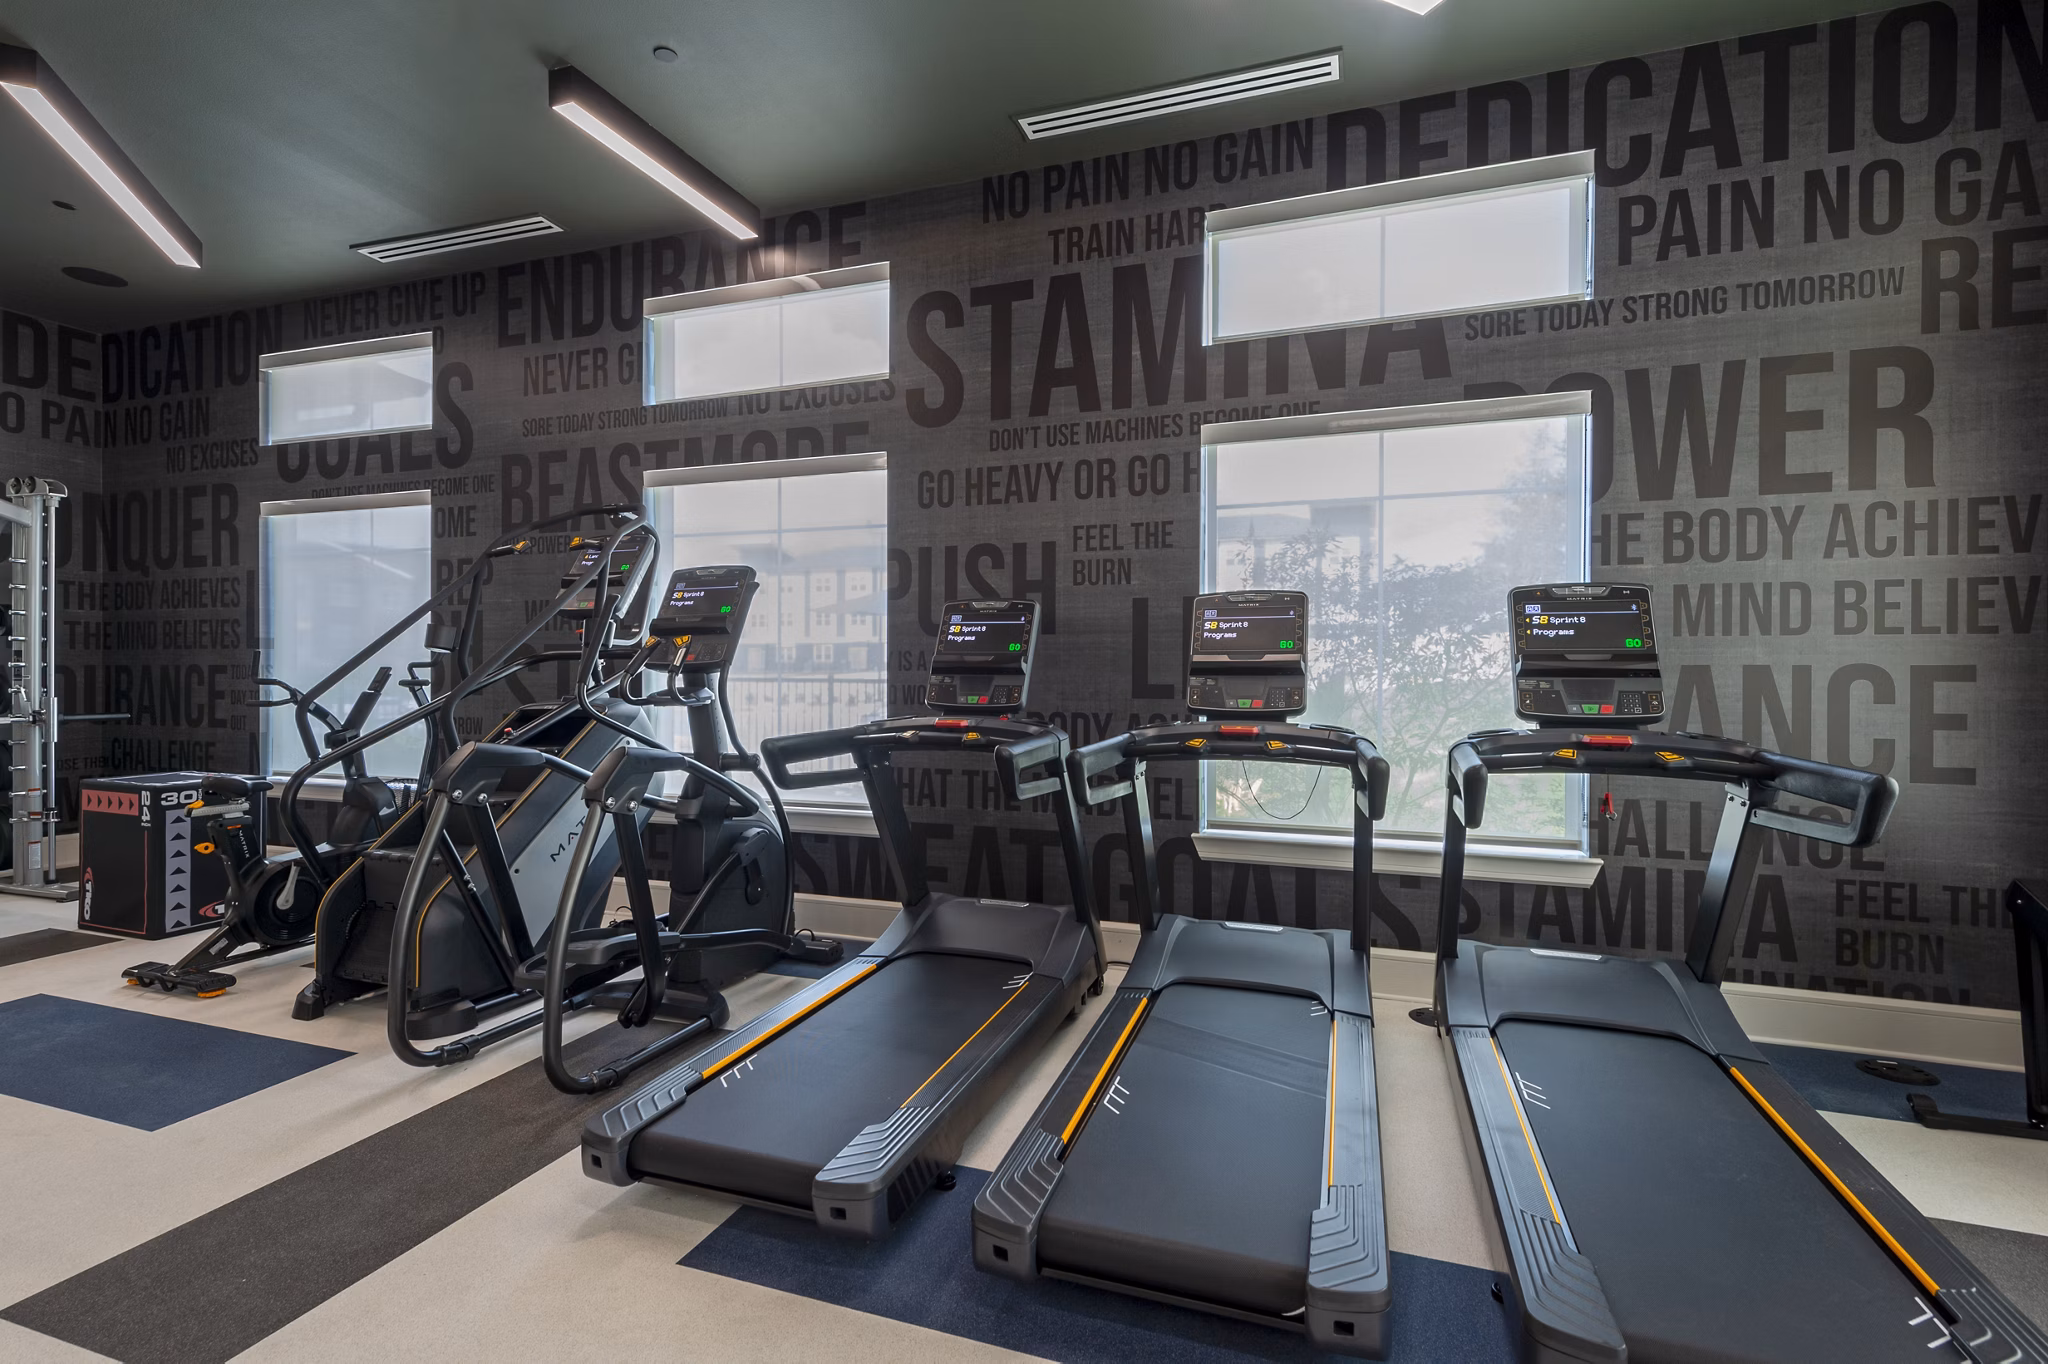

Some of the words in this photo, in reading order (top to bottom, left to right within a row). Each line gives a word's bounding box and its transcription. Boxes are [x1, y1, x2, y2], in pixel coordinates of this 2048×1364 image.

[982, 170, 1031, 224] NO
[1044, 152, 1130, 212] PAIN
[1144, 138, 1199, 197] NO
[1214, 118, 1314, 184] GAIN
[1617, 175, 1775, 267] PAIN
[1803, 157, 1905, 244] NO
[1935, 140, 2042, 227] GA
[1048, 216, 1135, 266] TRAIN
[1146, 203, 1228, 253] HAR
[303, 288, 379, 341] NEVER
[388, 278, 444, 327] GIVE
[451, 271, 486, 318] UP
[1465, 308, 1526, 341] SORE
[1537, 298, 1616, 334] TODAY
[1622, 284, 1728, 325] STRONG
[1736, 266, 1905, 312] TOMORROW
[523, 347, 609, 397] NEVER
[41, 398, 117, 449] PAIN
[124, 404, 152, 446] NO
[160, 396, 210, 443] GAIN
[522, 417, 553, 438] SORE
[556, 411, 595, 435] TODAY
[598, 405, 647, 431] STRONG
[653, 397, 728, 426] TOMORROW
[989, 425, 1040, 452] DON'T
[1046, 422, 1080, 447] USE
[1086, 413, 1184, 445] MACHINES
[167, 445, 186, 474] NO
[191, 437, 259, 471] EXCUSES
[473, 474, 495, 493] ONE
[916, 469, 955, 510] GO
[964, 462, 1064, 507] HEAVY
[1073, 458, 1117, 500] OR
[1127, 454, 1171, 497] GO
[434, 505, 477, 539] OME
[1072, 523, 1123, 553] FEEL
[1131, 520, 1174, 549] THE
[1592, 512, 1645, 566] HE
[1663, 504, 1806, 564] BODY
[1824, 494, 2041, 560] ACHIEV
[1072, 557, 1132, 587] BURN
[58, 579, 108, 611] THE
[114, 579, 155, 611] BODY
[160, 576, 240, 609] ACHIEVES
[1672, 580, 1811, 637] MIND
[1832, 575, 2041, 636] BELIEV
[63, 620, 111, 650] THE
[117, 620, 157, 650] MIND
[163, 618, 240, 650] BELIEVES
[1219, 621, 1242, 629] Sprint
[1532, 615, 1548, 624] S8
[1550, 616, 1579, 625] Sprint
[1533, 628, 1574, 637] Programs
[1280, 640, 1294, 648] GO
[1625, 638, 1642, 648] GO
[230, 715, 247, 731] OUT
[111, 737, 216, 773] CHALLENGE
[160, 789, 198, 806] 30
[238, 829, 250, 859] MATRIX
[1835, 878, 1931, 923] FEEL
[1835, 927, 1944, 975] BURN
